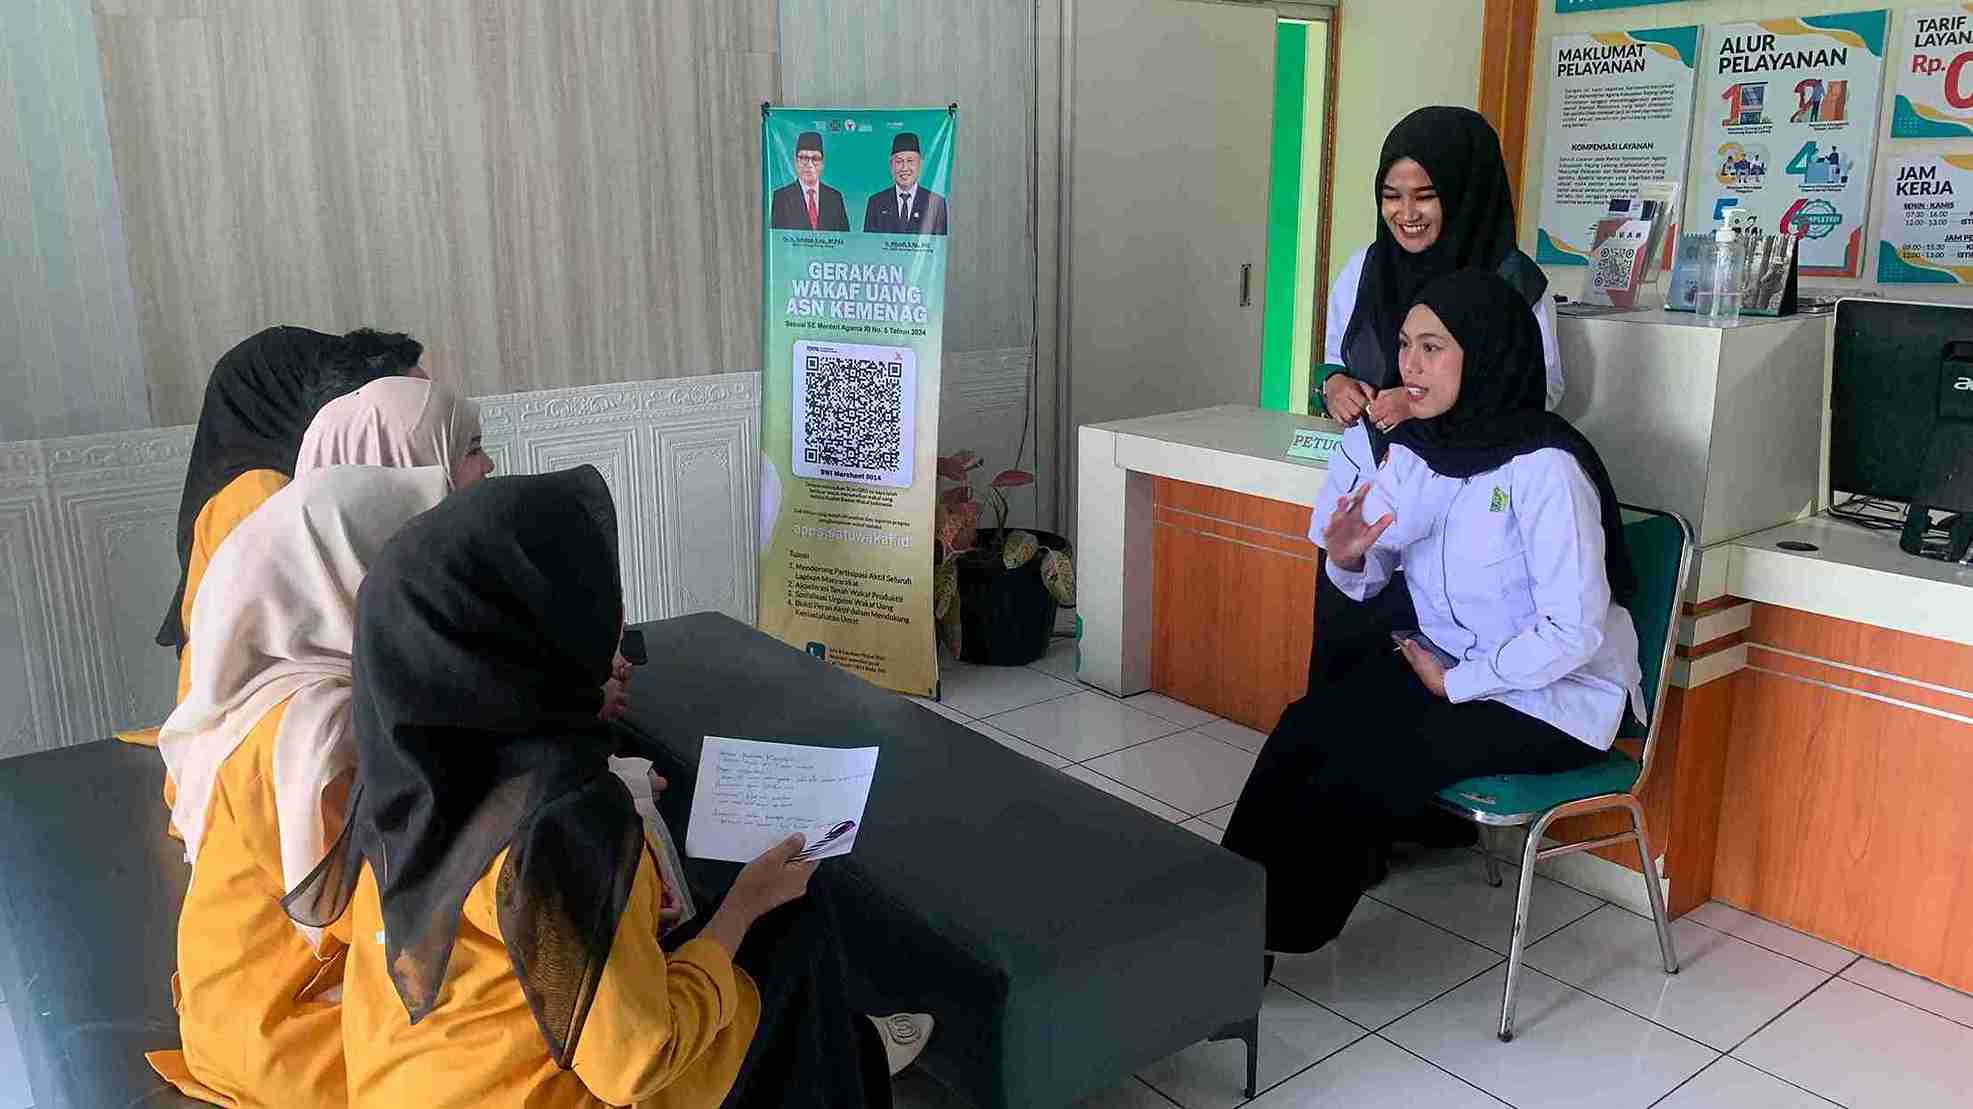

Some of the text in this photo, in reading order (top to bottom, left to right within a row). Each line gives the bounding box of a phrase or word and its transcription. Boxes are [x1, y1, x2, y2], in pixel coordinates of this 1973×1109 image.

[1917, 16, 1967, 33] TARIF
[1719, 34, 1776, 55] ALUR
[1914, 31, 1973, 48] LAYAN
[1558, 44, 1647, 63] MAKLUMAT
[1718, 48, 1847, 74] PELAYANAN
[1557, 59, 1646, 77] PELAYANAN
[1912, 54, 1945, 76] Rp.
[1571, 142, 1654, 151] KOMPENSASI LAYANAN
[1897, 165, 1936, 181] JAM
[1896, 180, 1953, 196] KERJA
[808, 261, 903, 284] GERAKAN
[792, 279, 921, 305] WAKAF UANG
[786, 297, 928, 322] ASN KEMENAG
[841, 324, 862, 334] Agama
